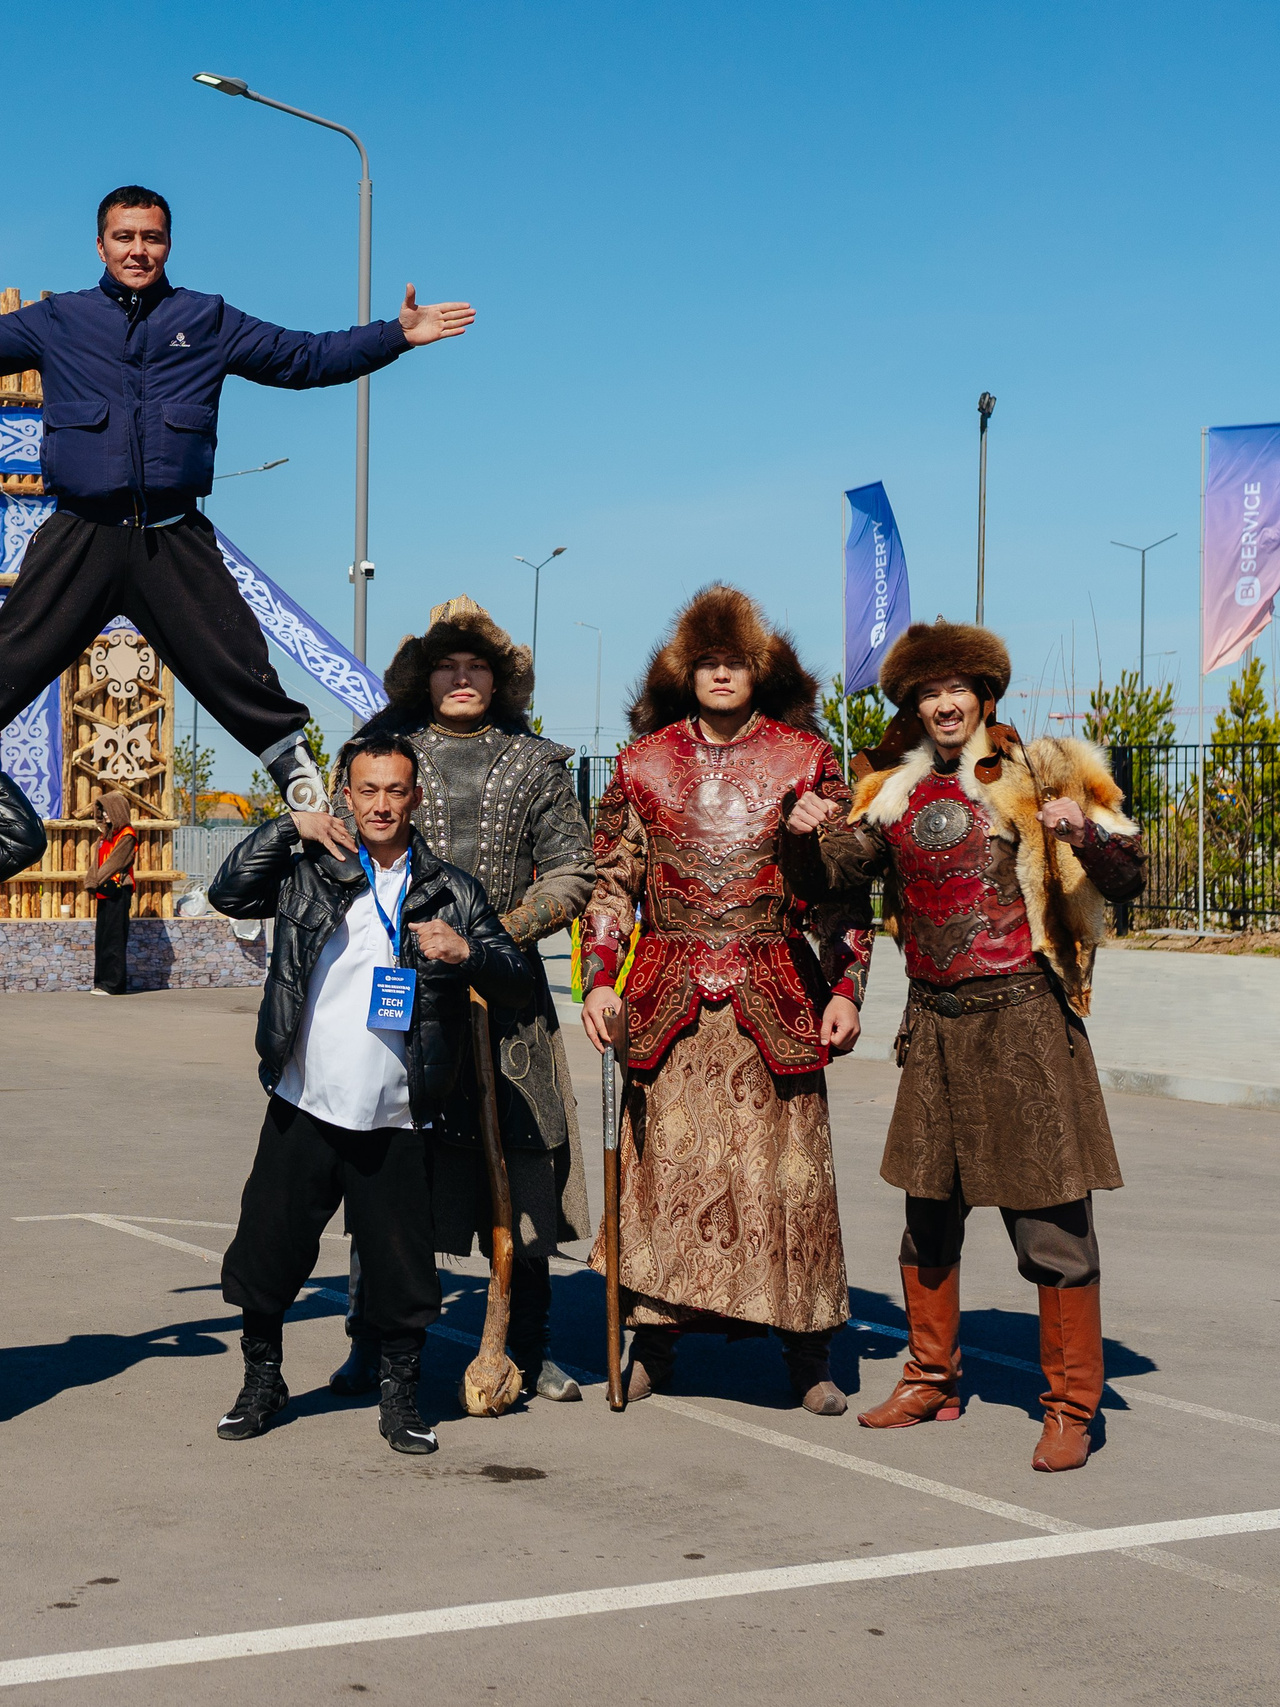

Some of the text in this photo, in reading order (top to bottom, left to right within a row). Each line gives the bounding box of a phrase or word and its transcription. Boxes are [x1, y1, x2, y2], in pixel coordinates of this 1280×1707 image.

[1240, 481, 1261, 573] SERVICE
[871, 519, 888, 621] PROPERTY
[377, 1008, 404, 1018] CREW
[381, 997, 403, 1007] TECH
